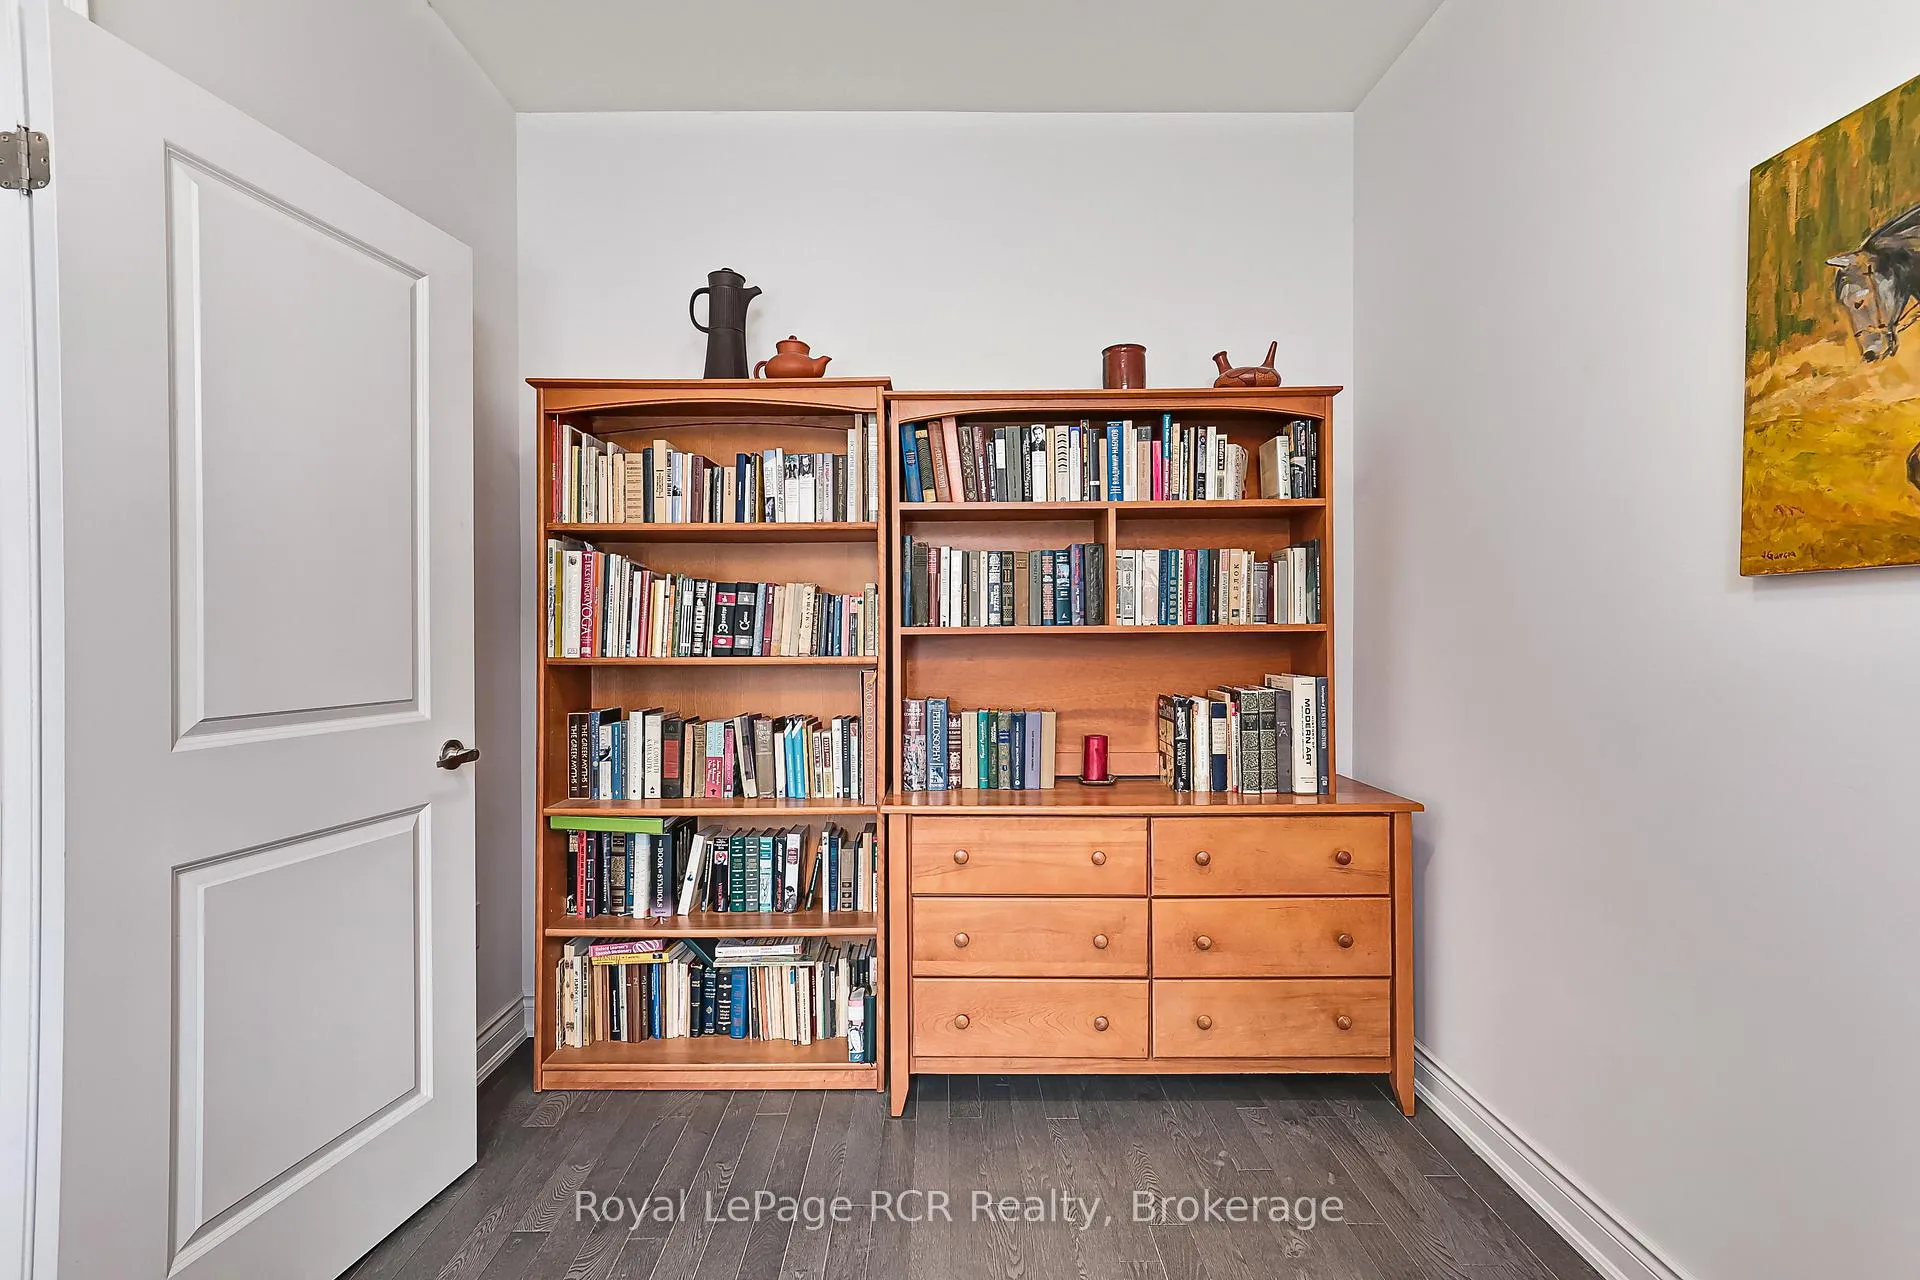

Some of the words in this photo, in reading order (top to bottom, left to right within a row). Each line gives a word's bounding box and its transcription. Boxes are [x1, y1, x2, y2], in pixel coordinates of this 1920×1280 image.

[1112, 455, 1120, 484] ВЛАДИМИР
[581, 601, 592, 635] YOGA
[866, 682, 874, 715] СЛОВО
[866, 724, 874, 757] ПОЛКУ
[932, 711, 940, 762] PHILOSOPHY
